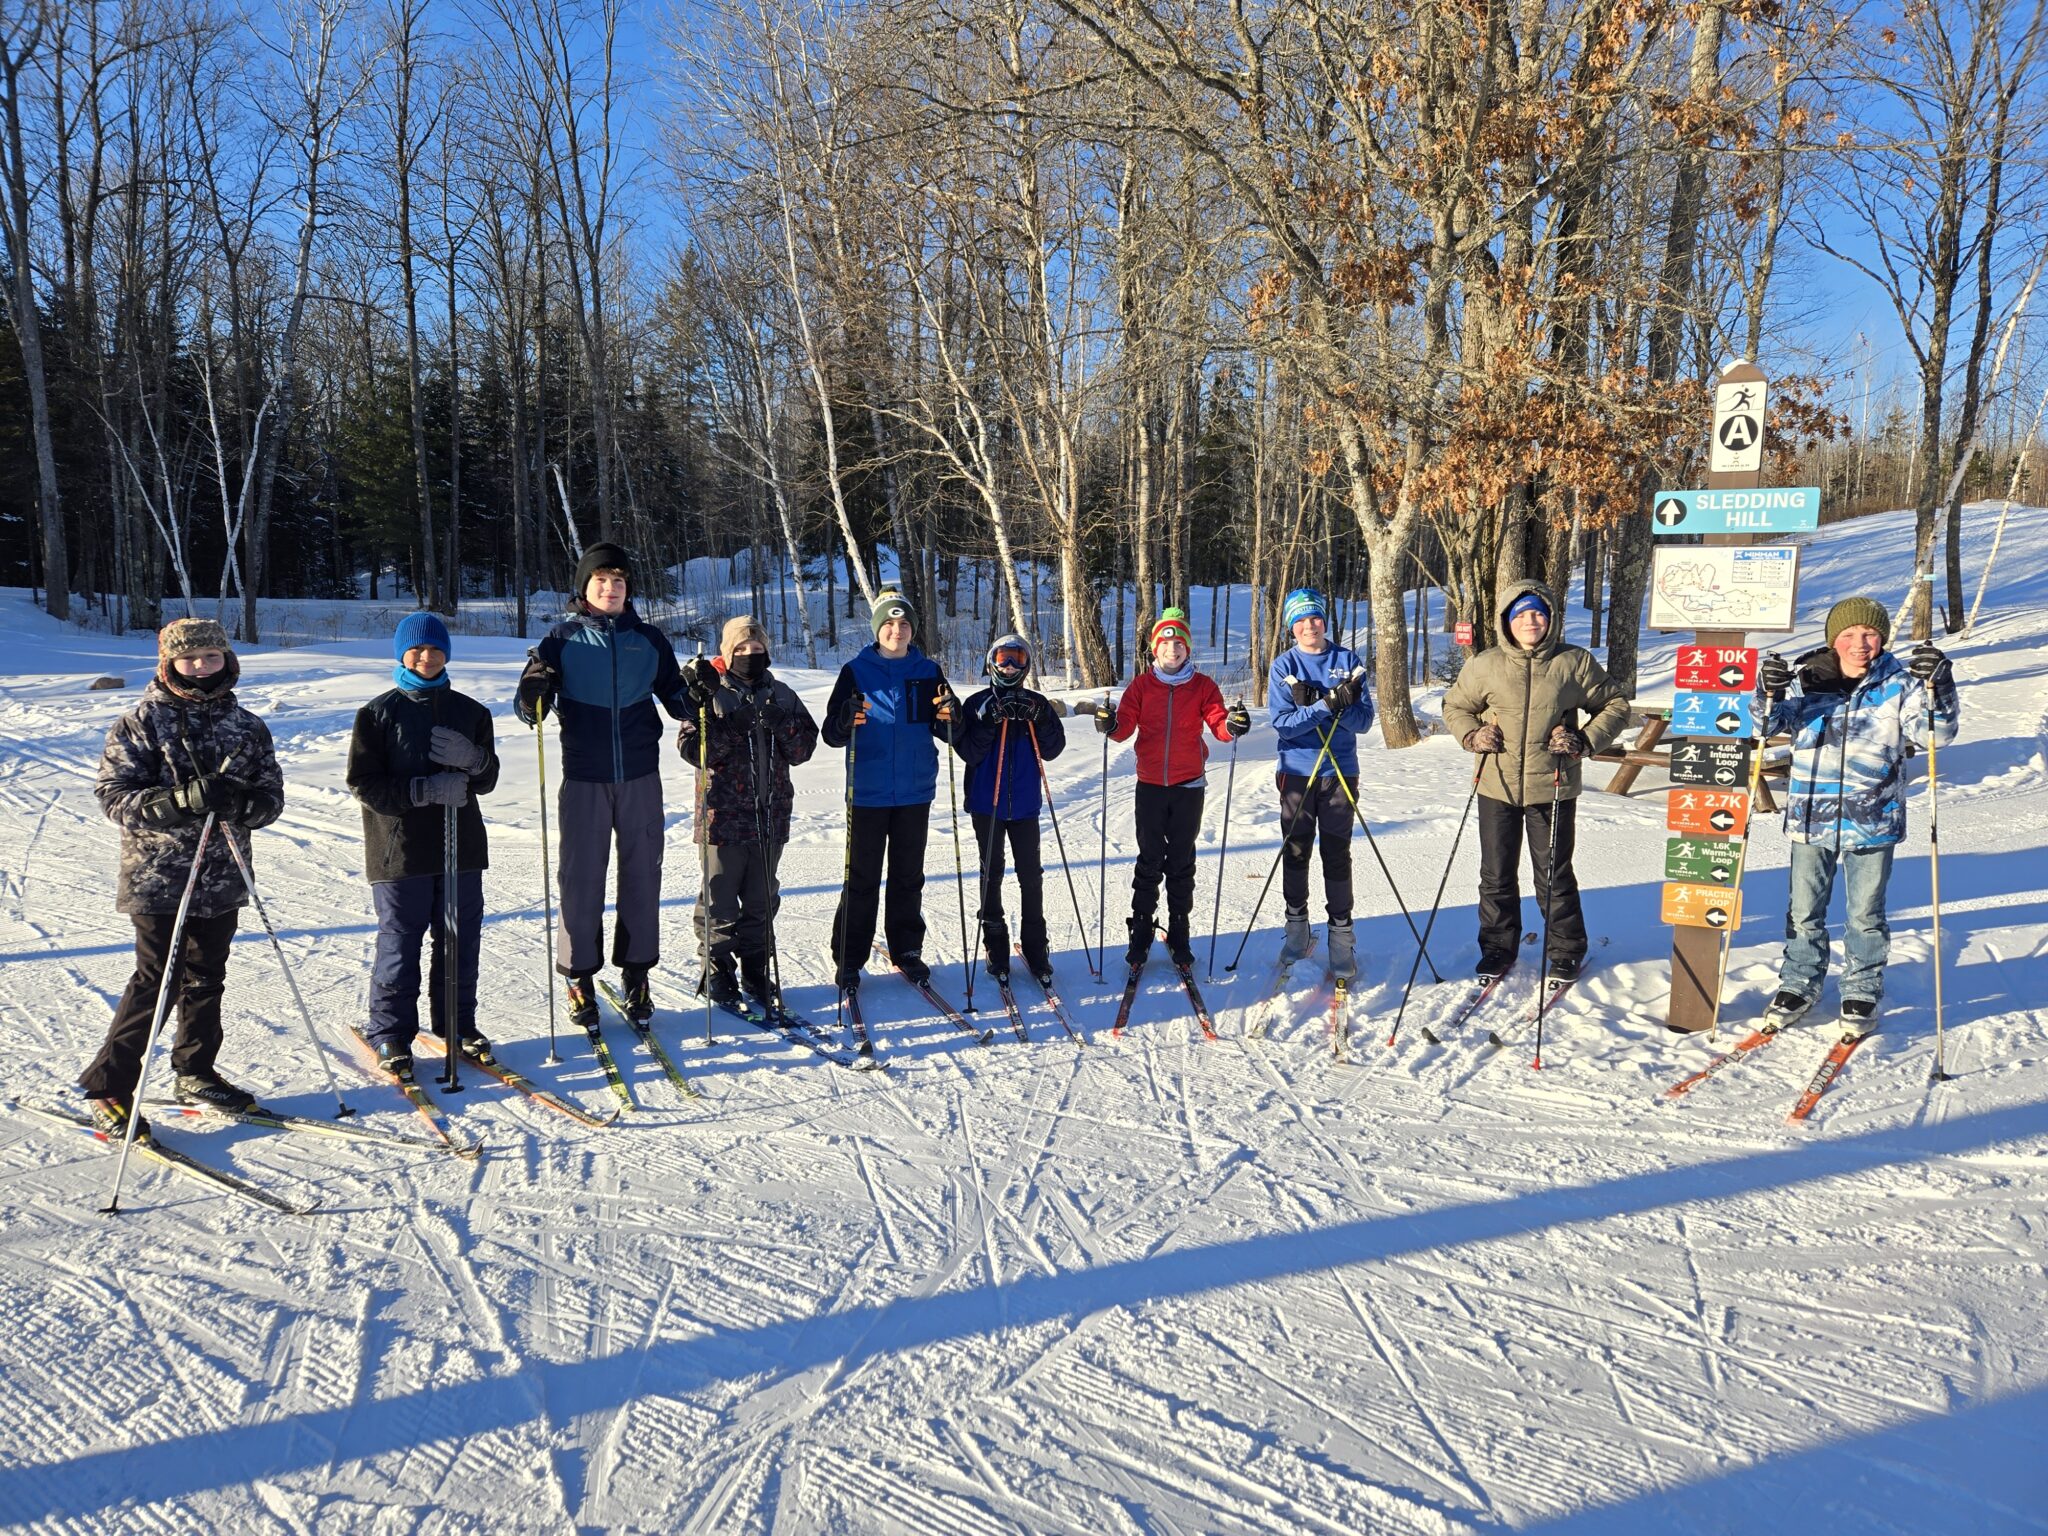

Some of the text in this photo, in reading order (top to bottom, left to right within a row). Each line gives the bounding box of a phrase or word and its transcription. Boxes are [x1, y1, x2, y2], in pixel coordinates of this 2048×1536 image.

[1724, 416, 1752, 446] A
[1696, 492, 1805, 510] SLEDDING
[1726, 511, 1773, 527] HILL
[888, 607, 905, 618] G
[1716, 650, 1748, 663] 10K
[1718, 696, 1740, 711] 7K
[1710, 751, 1743, 760] Interval
[1716, 759, 1738, 767] Loop
[1704, 794, 1742, 809] 2.7K
[1713, 842, 1731, 850] 1.6K
[1701, 848, 1741, 859] Warm-Up
[1711, 857, 1733, 866] Loop
[1695, 889, 1735, 899] PRACTIC
[1704, 898, 1730, 907] LOOP
